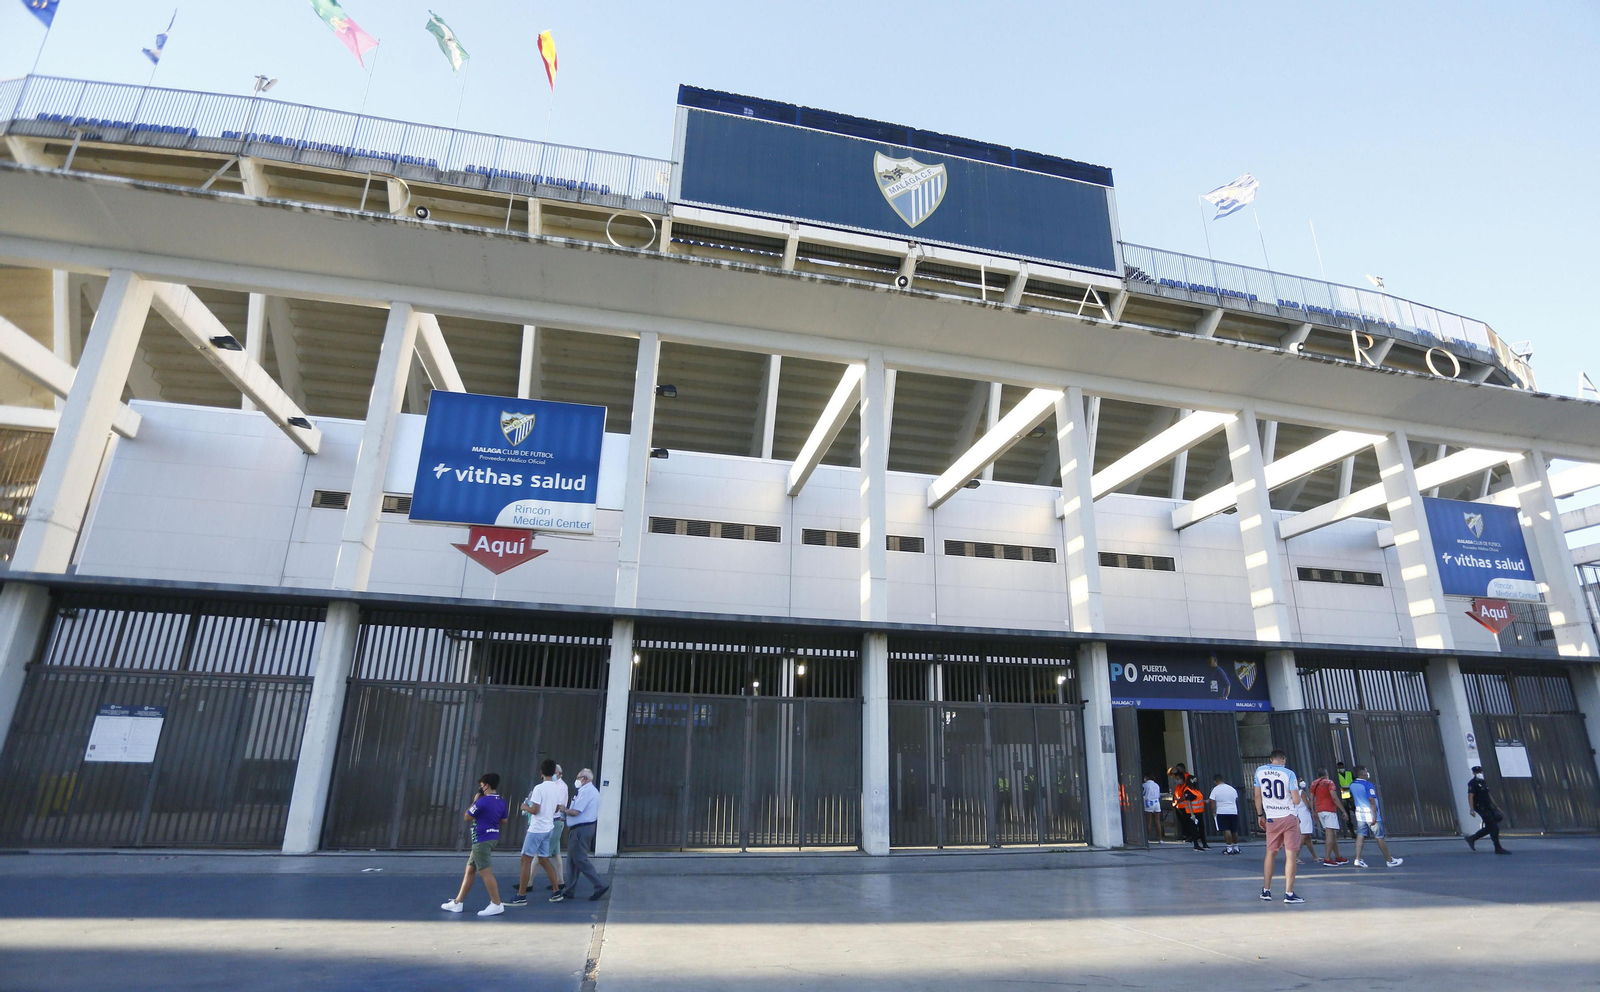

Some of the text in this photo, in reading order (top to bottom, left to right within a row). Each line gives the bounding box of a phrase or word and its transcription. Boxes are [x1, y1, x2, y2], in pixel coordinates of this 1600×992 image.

[471, 446, 502, 455] MALAGA
[502, 448, 520, 456] CLUB
[479, 454, 506, 463] Proveedor
[455, 466, 586, 491] vithas salud
[514, 504, 551, 516] Rincón
[513, 515, 591, 529] Medical Center
[473, 536, 525, 557] Aquí
[1453, 554, 1525, 572] vithas salud
[1495, 590, 1538, 600] Medical Center
[1481, 605, 1508, 621] Aquí
[1141, 664, 1168, 673] PUERTA
[1142, 674, 1205, 684] ANTONIO BENÍTEZ
[1261, 778, 1285, 800] 30
